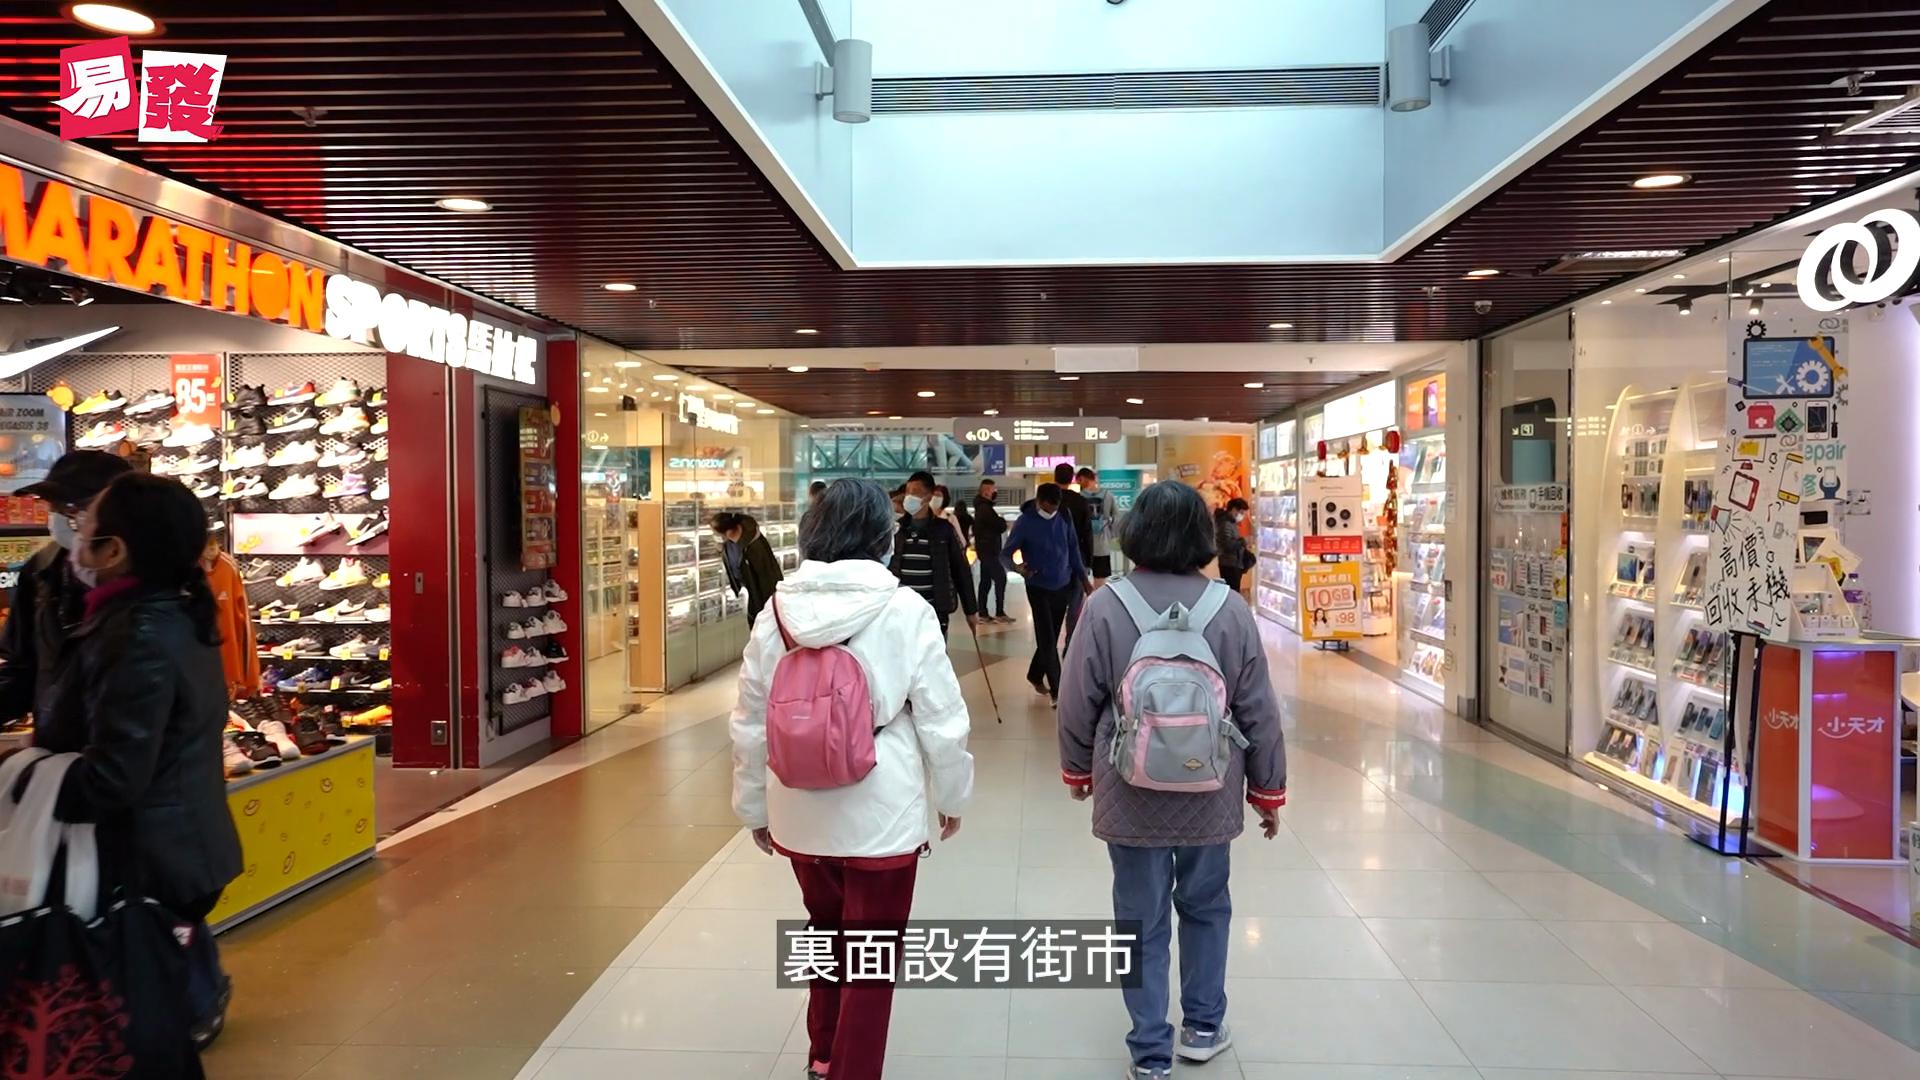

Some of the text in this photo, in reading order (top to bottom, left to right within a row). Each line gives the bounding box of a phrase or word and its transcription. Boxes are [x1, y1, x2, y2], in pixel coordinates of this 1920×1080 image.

[325, 274, 468, 368] SPORTS
[175, 378, 207, 413] 85
[16, 408, 45, 417] ZOOM
[1768, 707, 1799, 730] 小天才
[1826, 716, 1885, 735] 小天才
